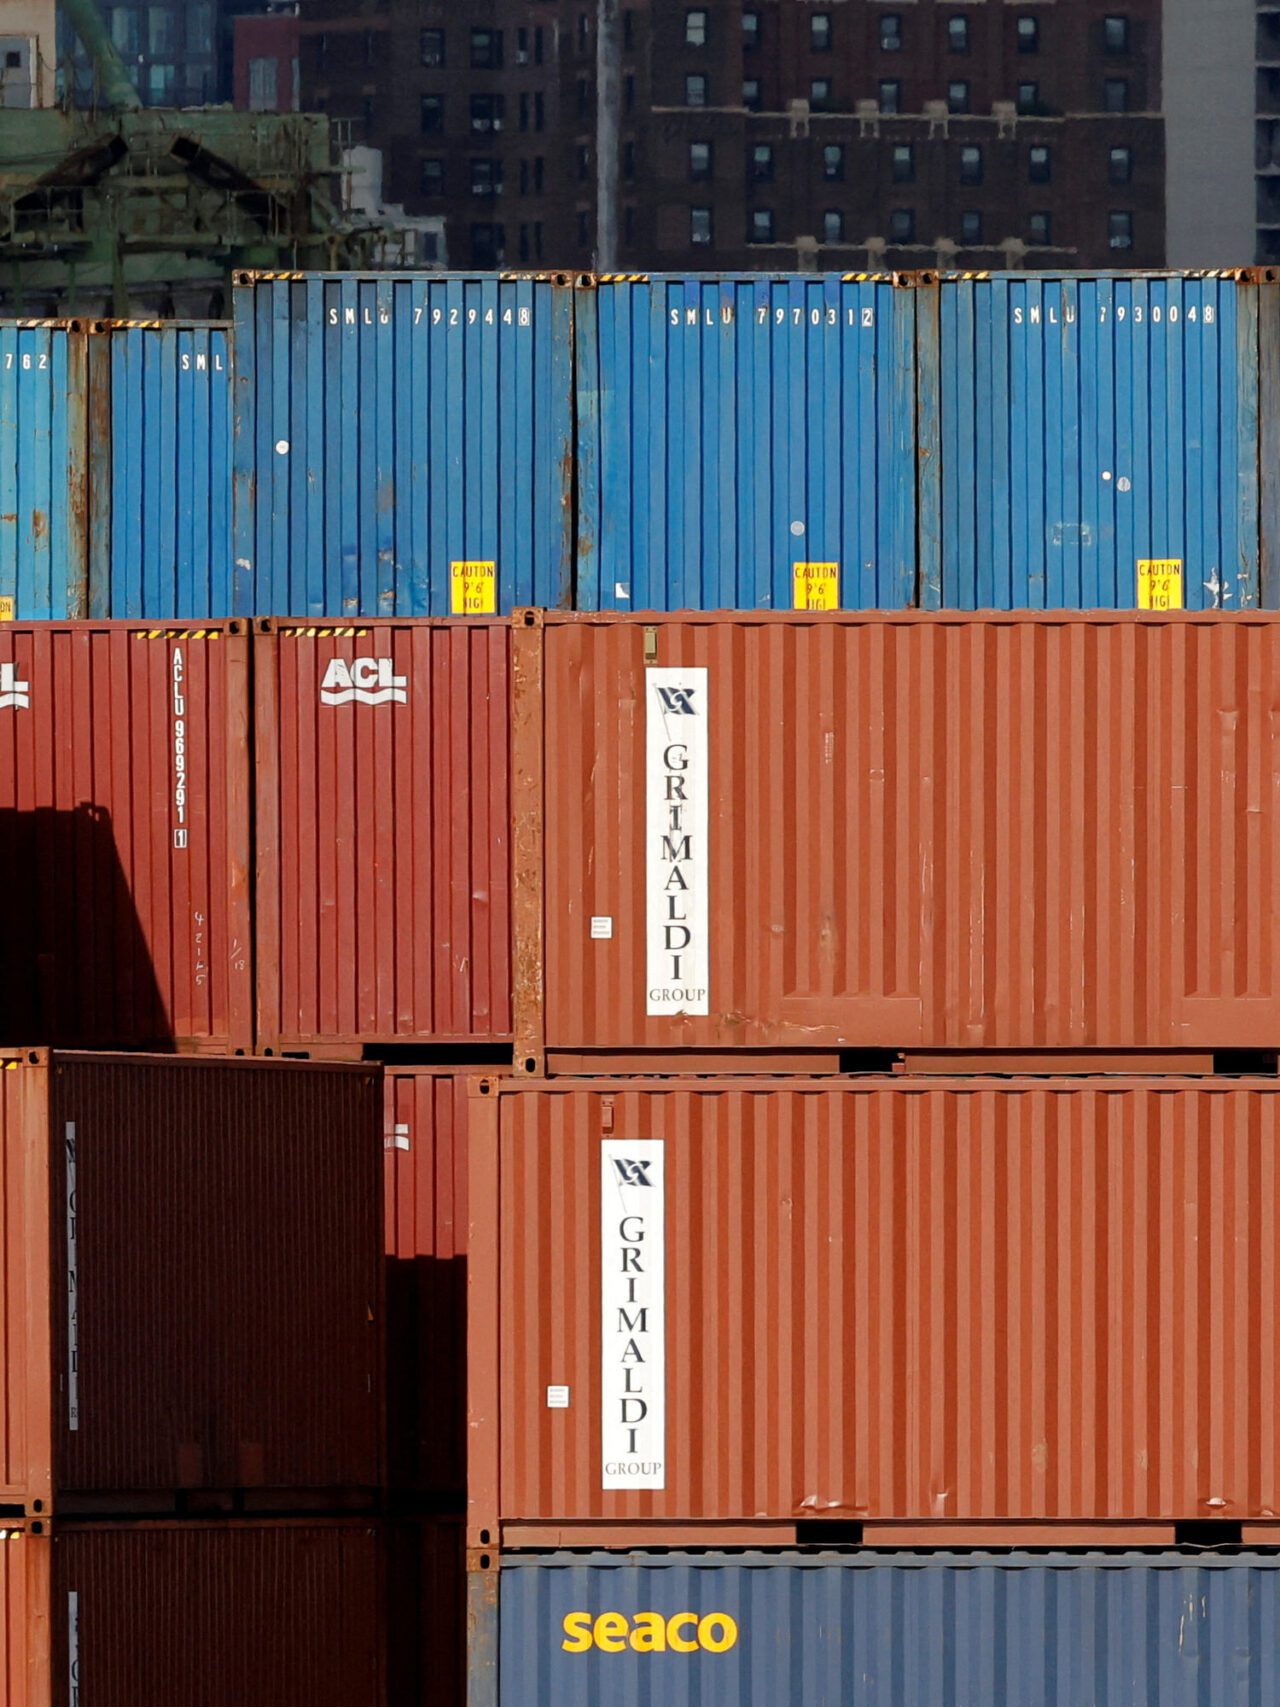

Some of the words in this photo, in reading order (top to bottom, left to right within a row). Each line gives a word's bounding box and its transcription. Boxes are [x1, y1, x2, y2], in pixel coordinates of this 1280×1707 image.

[329, 307, 389, 325] SMLU
[414, 307, 530, 326] 7929448
[670, 308, 733, 326] SMLU
[757, 307, 873, 327] 7970312
[1014, 305, 1076, 324] SMLU
[1099, 305, 1215, 324] 7930048
[181, 353, 235, 370] SML
[173, 647, 185, 717] ACLU
[320, 657, 407, 688] ACL
[174, 719, 187, 824] 969291
[660, 743, 694, 981] GRIMALDI
[649, 987, 706, 1002] GROUP
[616, 1216, 650, 1454] GRIMALDI
[604, 1462, 663, 1477] GROUP
[561, 1611, 738, 1653] seaco
